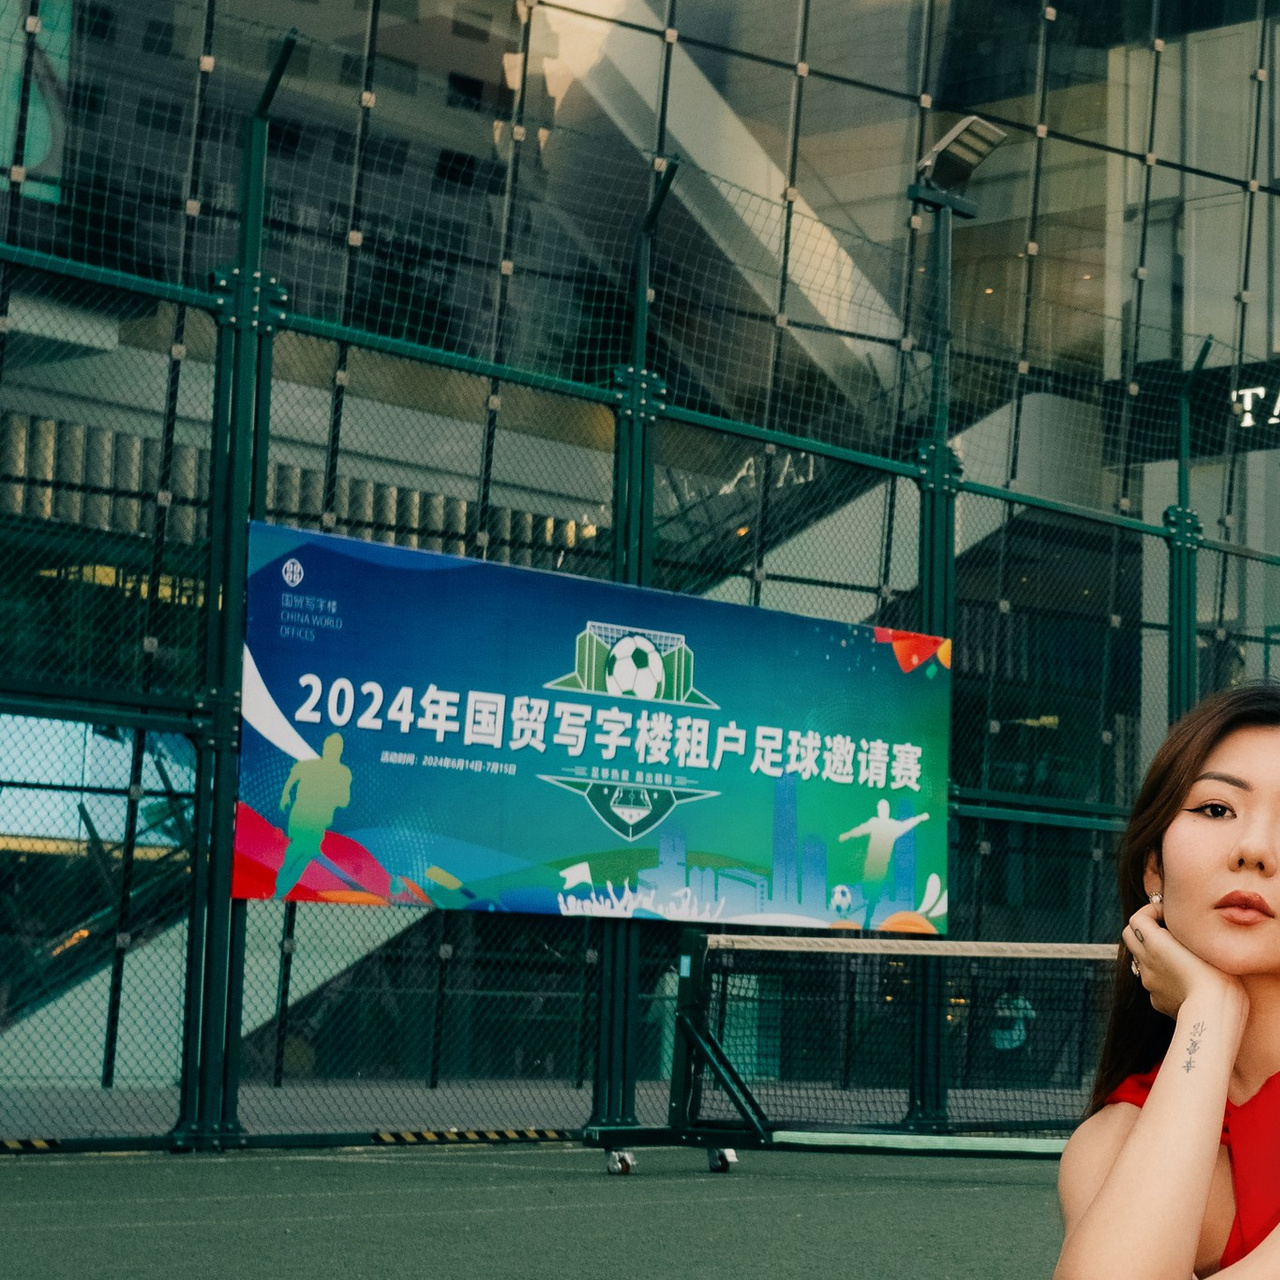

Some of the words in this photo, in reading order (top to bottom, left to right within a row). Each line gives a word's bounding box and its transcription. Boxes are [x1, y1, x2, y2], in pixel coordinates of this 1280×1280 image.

[280, 609, 310, 626] CHINA
[312, 614, 343, 630] WORLD
[280, 624, 315, 641] OFFICES
[294, 672, 923, 792] 2024年国贸写字楼租户足球邀请赛
